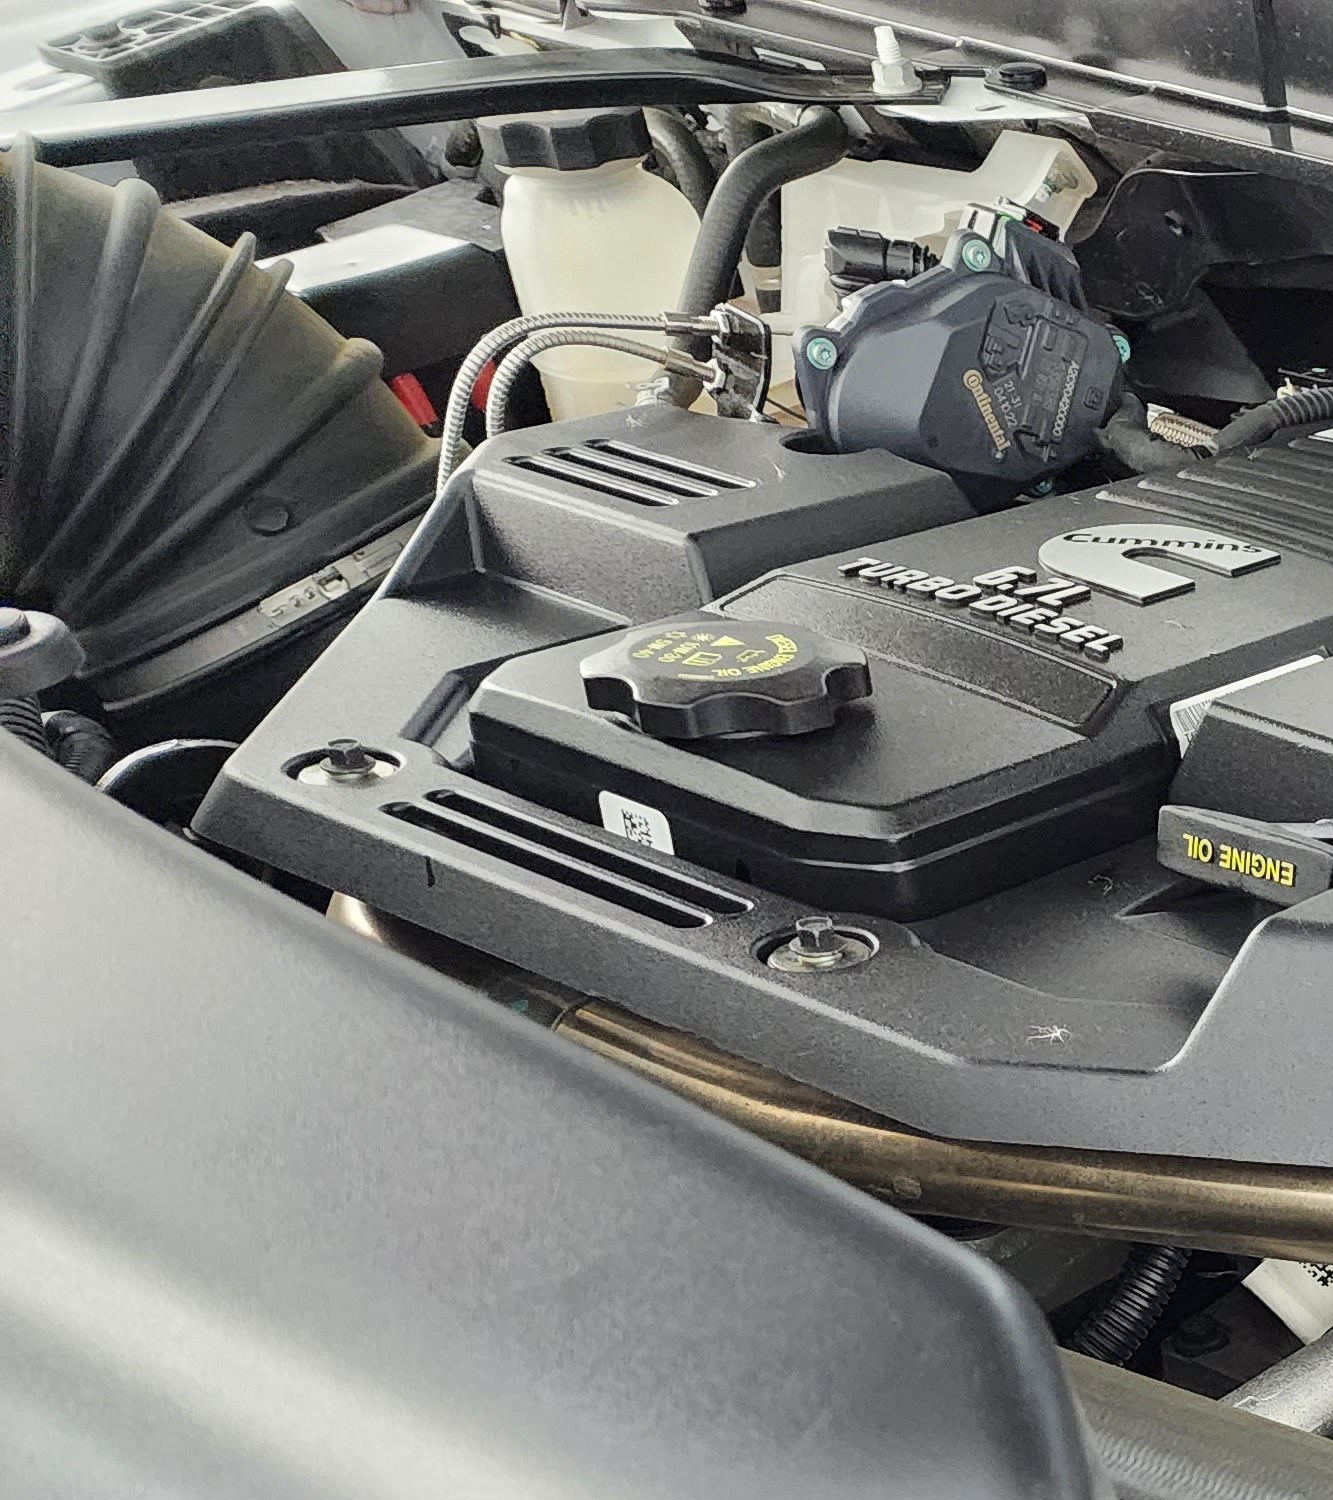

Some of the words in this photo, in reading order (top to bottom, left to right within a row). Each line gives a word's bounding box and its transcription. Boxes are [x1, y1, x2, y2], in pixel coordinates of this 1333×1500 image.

[963, 369, 1012, 451] Continental
[1062, 532, 1265, 555] Cummins
[837, 557, 983, 605] TURBO
[967, 594, 1125, 663] DIESEL
[972, 565, 1091, 612] 6.7L
[1182, 832, 1214, 863] OIL
[1218, 843, 1295, 887] ENGINE
